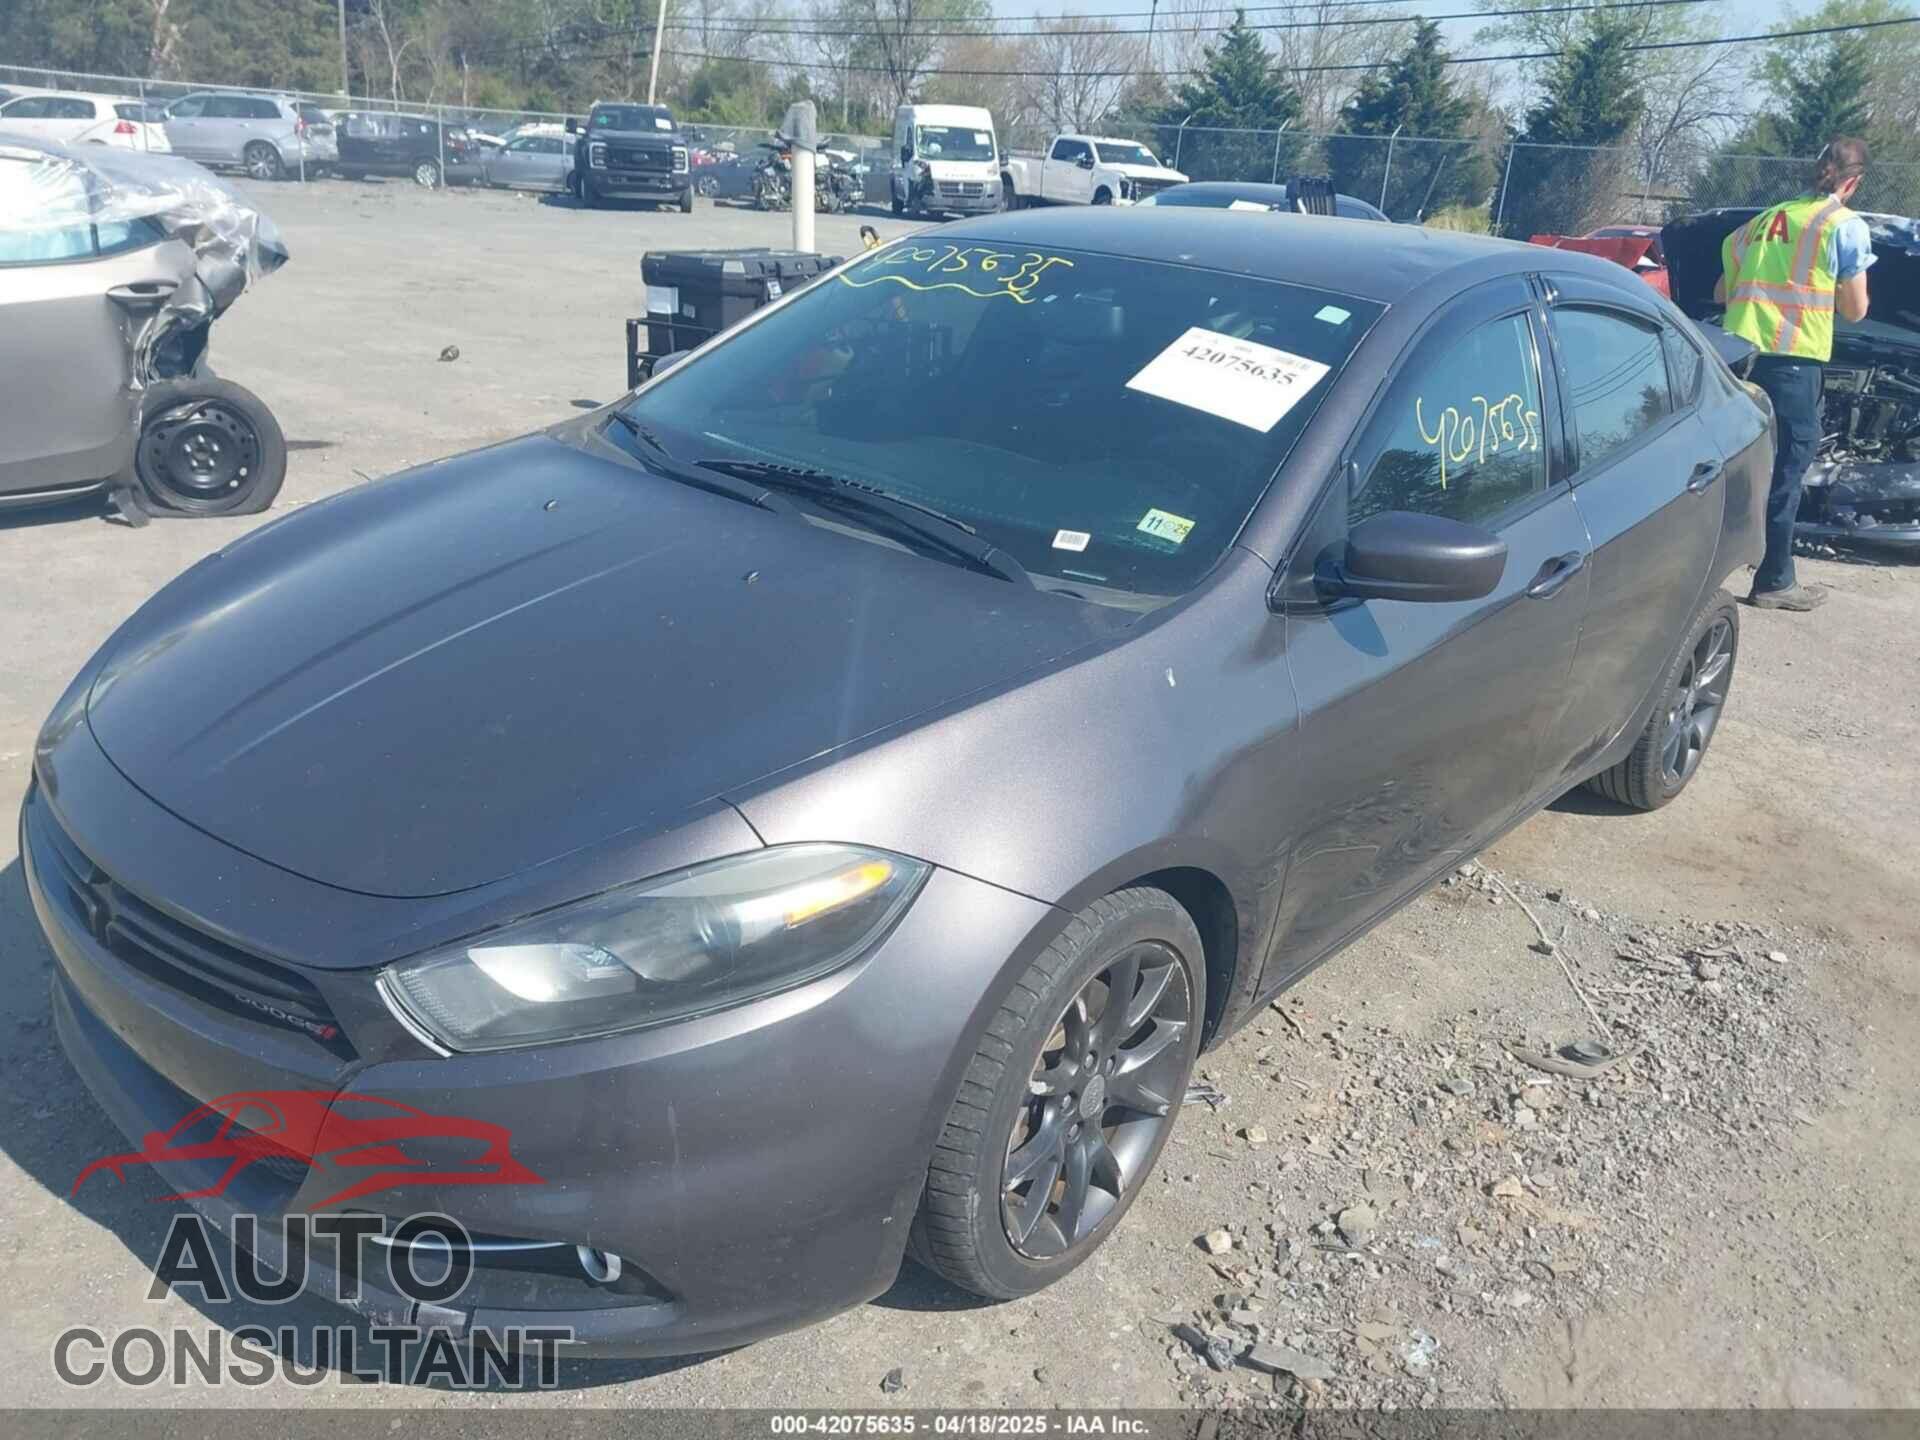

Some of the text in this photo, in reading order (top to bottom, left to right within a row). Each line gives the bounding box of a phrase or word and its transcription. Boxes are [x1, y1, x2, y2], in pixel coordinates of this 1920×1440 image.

[1182, 346, 1298, 385] 42075635
[1416, 394, 1538, 490] 42075635
[1146, 516, 1164, 530] 11
